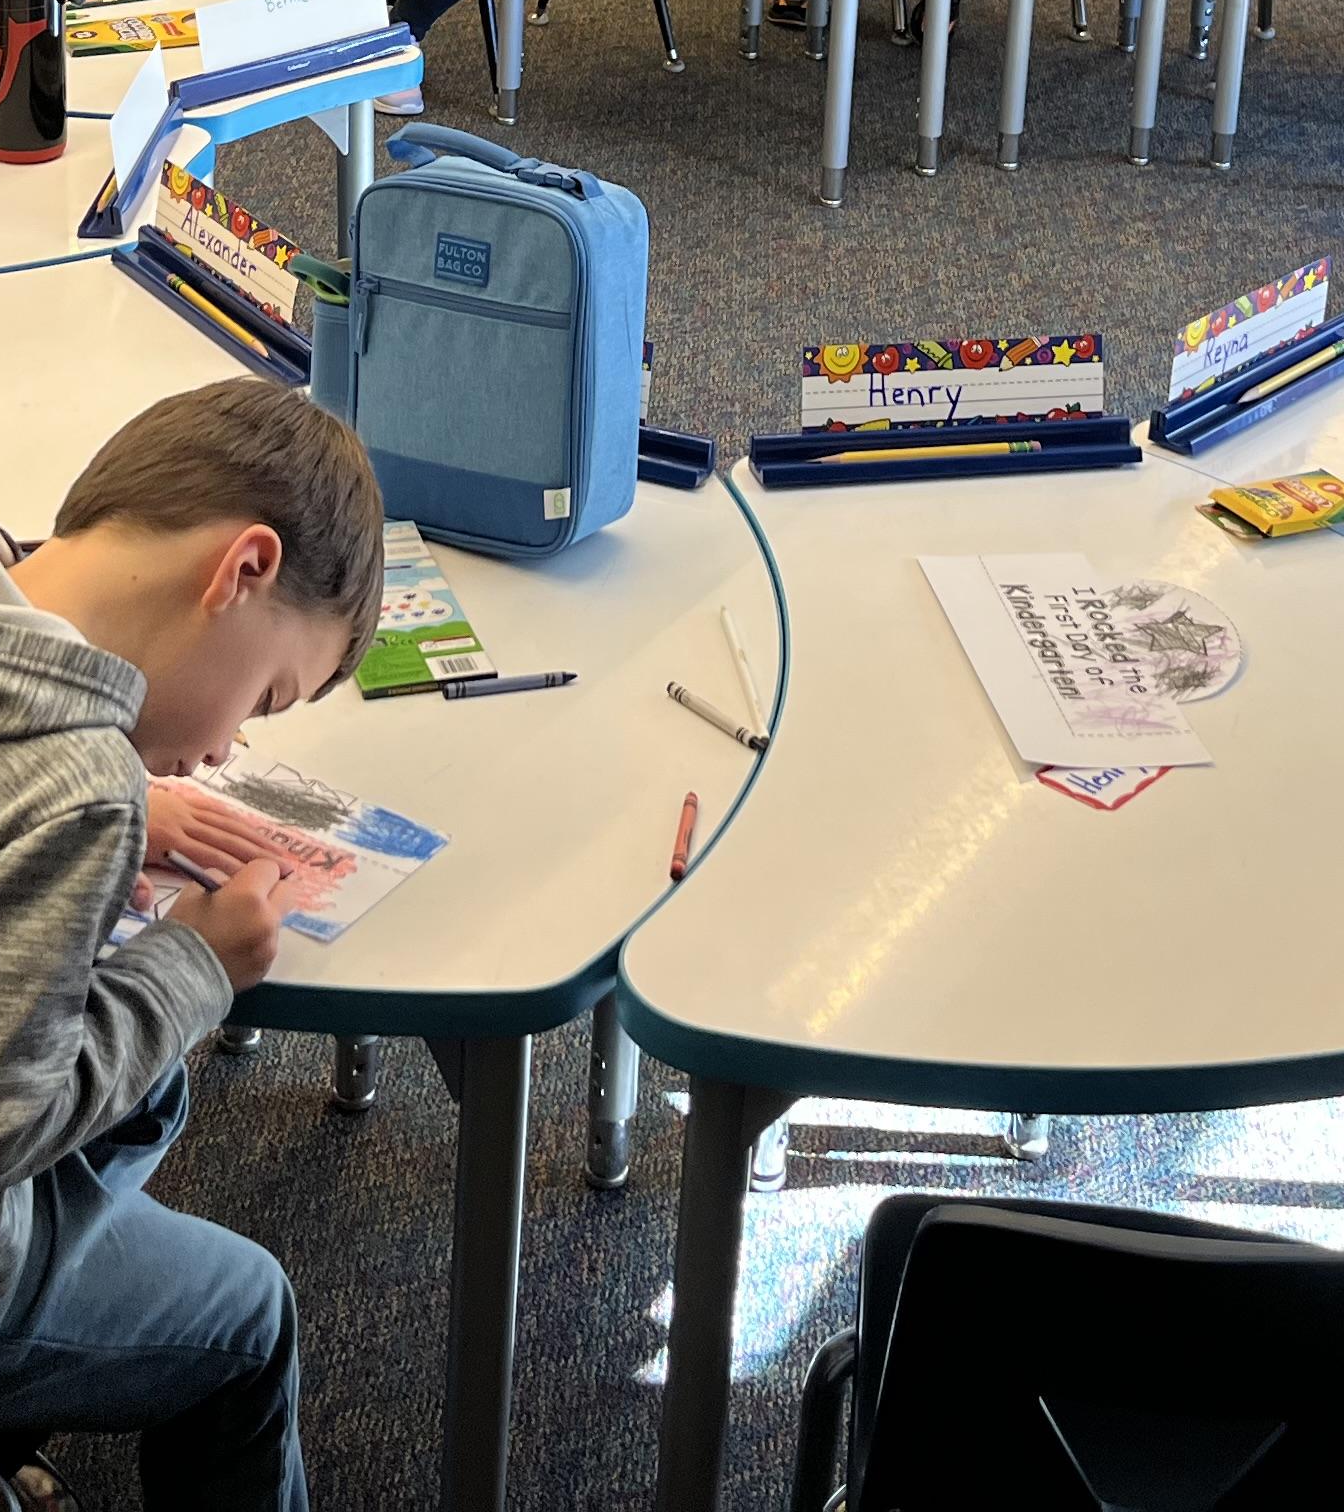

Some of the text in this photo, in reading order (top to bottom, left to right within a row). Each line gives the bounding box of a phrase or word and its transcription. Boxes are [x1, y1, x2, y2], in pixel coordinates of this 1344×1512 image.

[179, 207, 257, 279] Alexander
[437, 256, 483, 276] BAG CO
[438, 242, 486, 263] FULTON
[1204, 331, 1249, 373] Reyna
[868, 372, 963, 425] Henry
[998, 583, 1085, 700] Kindergarten!
[1043, 594, 1114, 687] First Day of
[1074, 598, 1140, 664] Rocked
[1119, 666, 1148, 695] the
